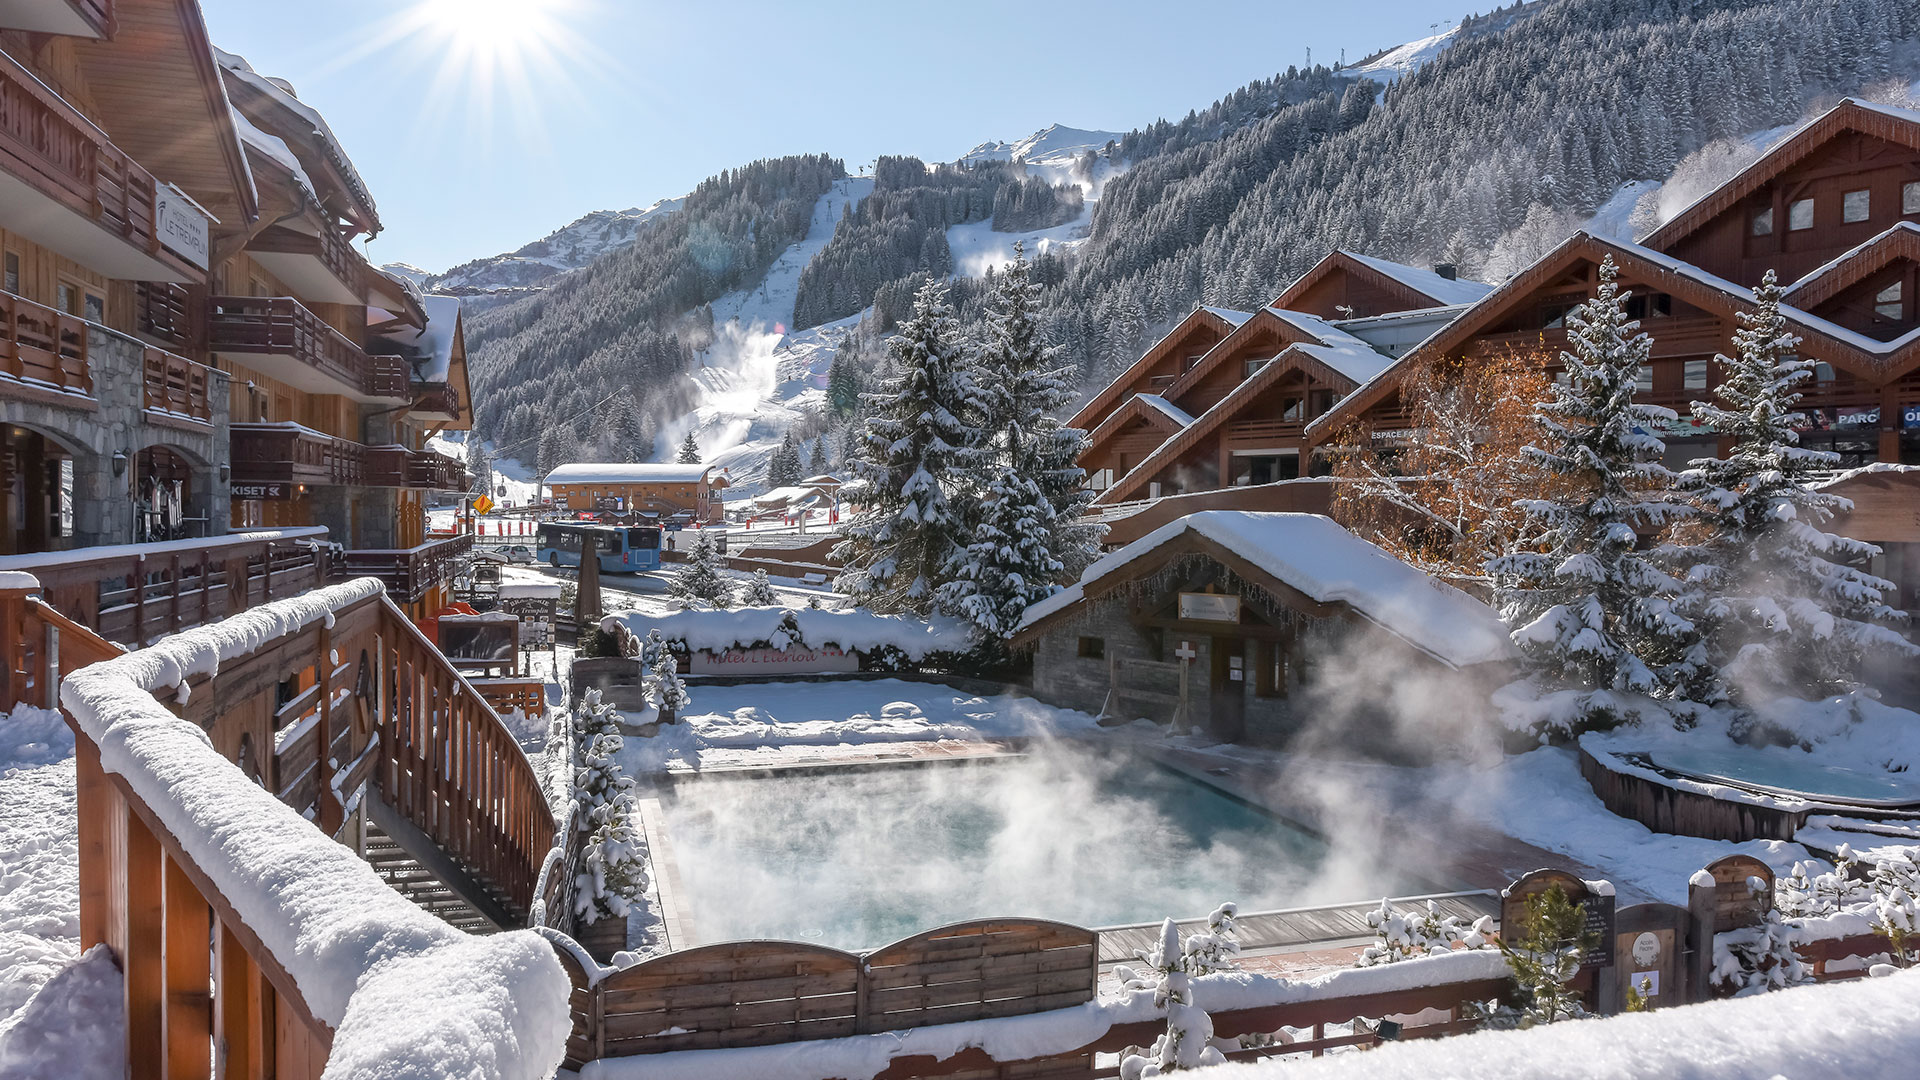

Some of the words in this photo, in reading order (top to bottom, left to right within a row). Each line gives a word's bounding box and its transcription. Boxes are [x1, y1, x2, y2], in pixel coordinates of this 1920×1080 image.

[1838, 413, 1878, 424] PARC
[1371, 430, 1401, 440] ESPACE
[521, 607, 549, 615] Tremplin
